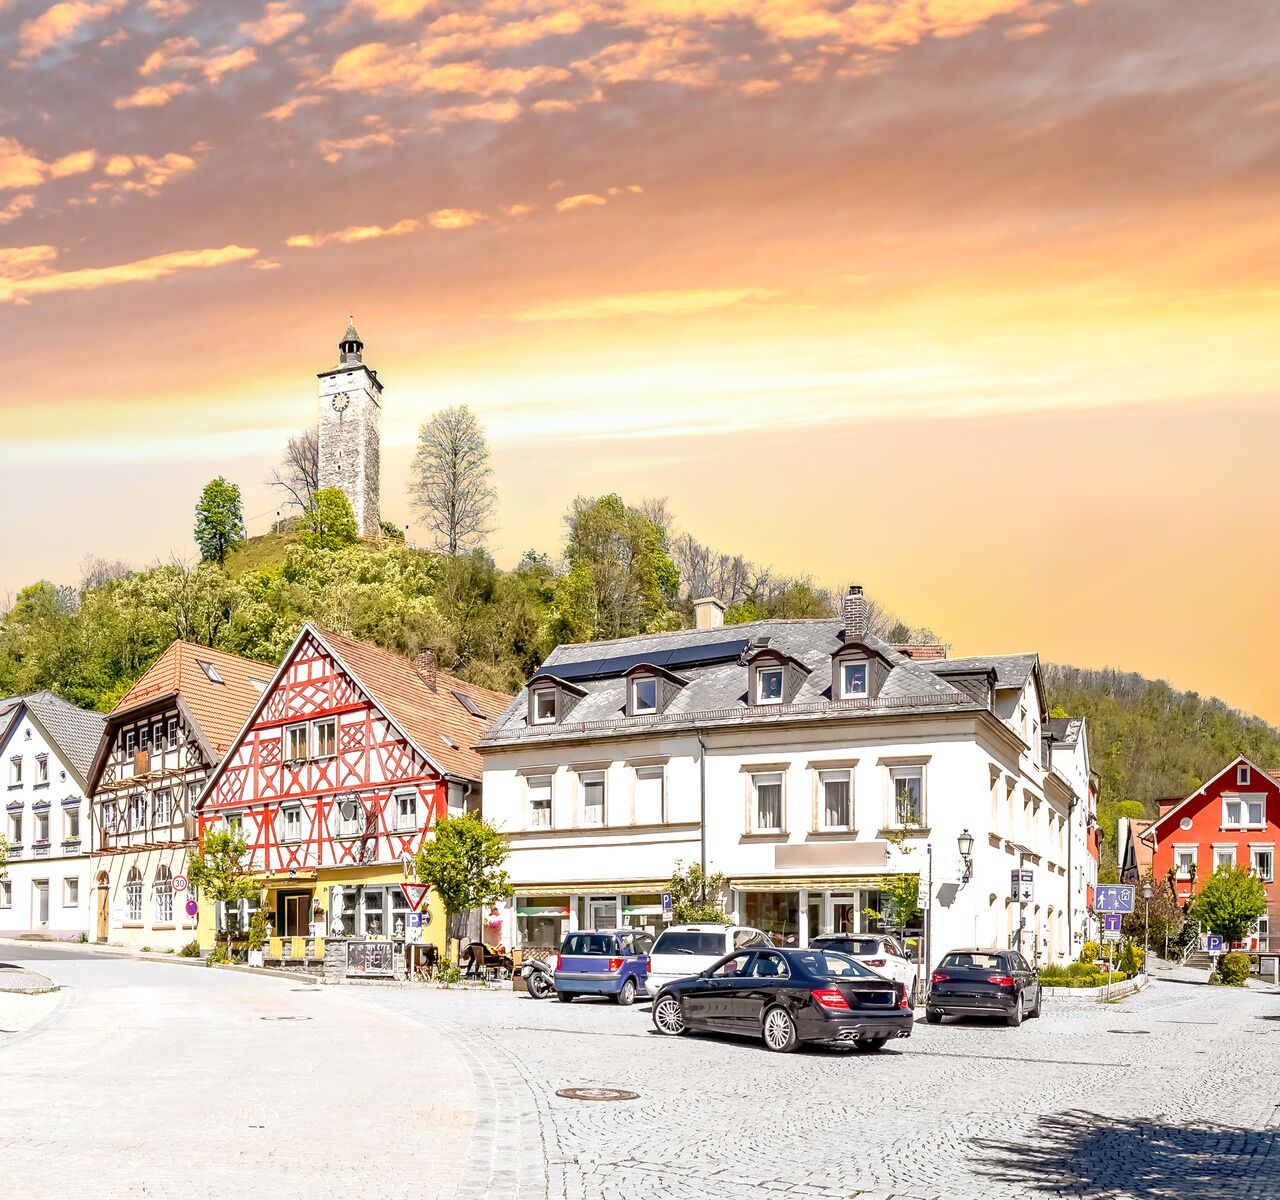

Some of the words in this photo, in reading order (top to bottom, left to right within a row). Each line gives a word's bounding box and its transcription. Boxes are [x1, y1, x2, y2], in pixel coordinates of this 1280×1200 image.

[664, 895, 669, 908] P
[410, 914, 419, 926] P
[1211, 938, 1219, 949] P
